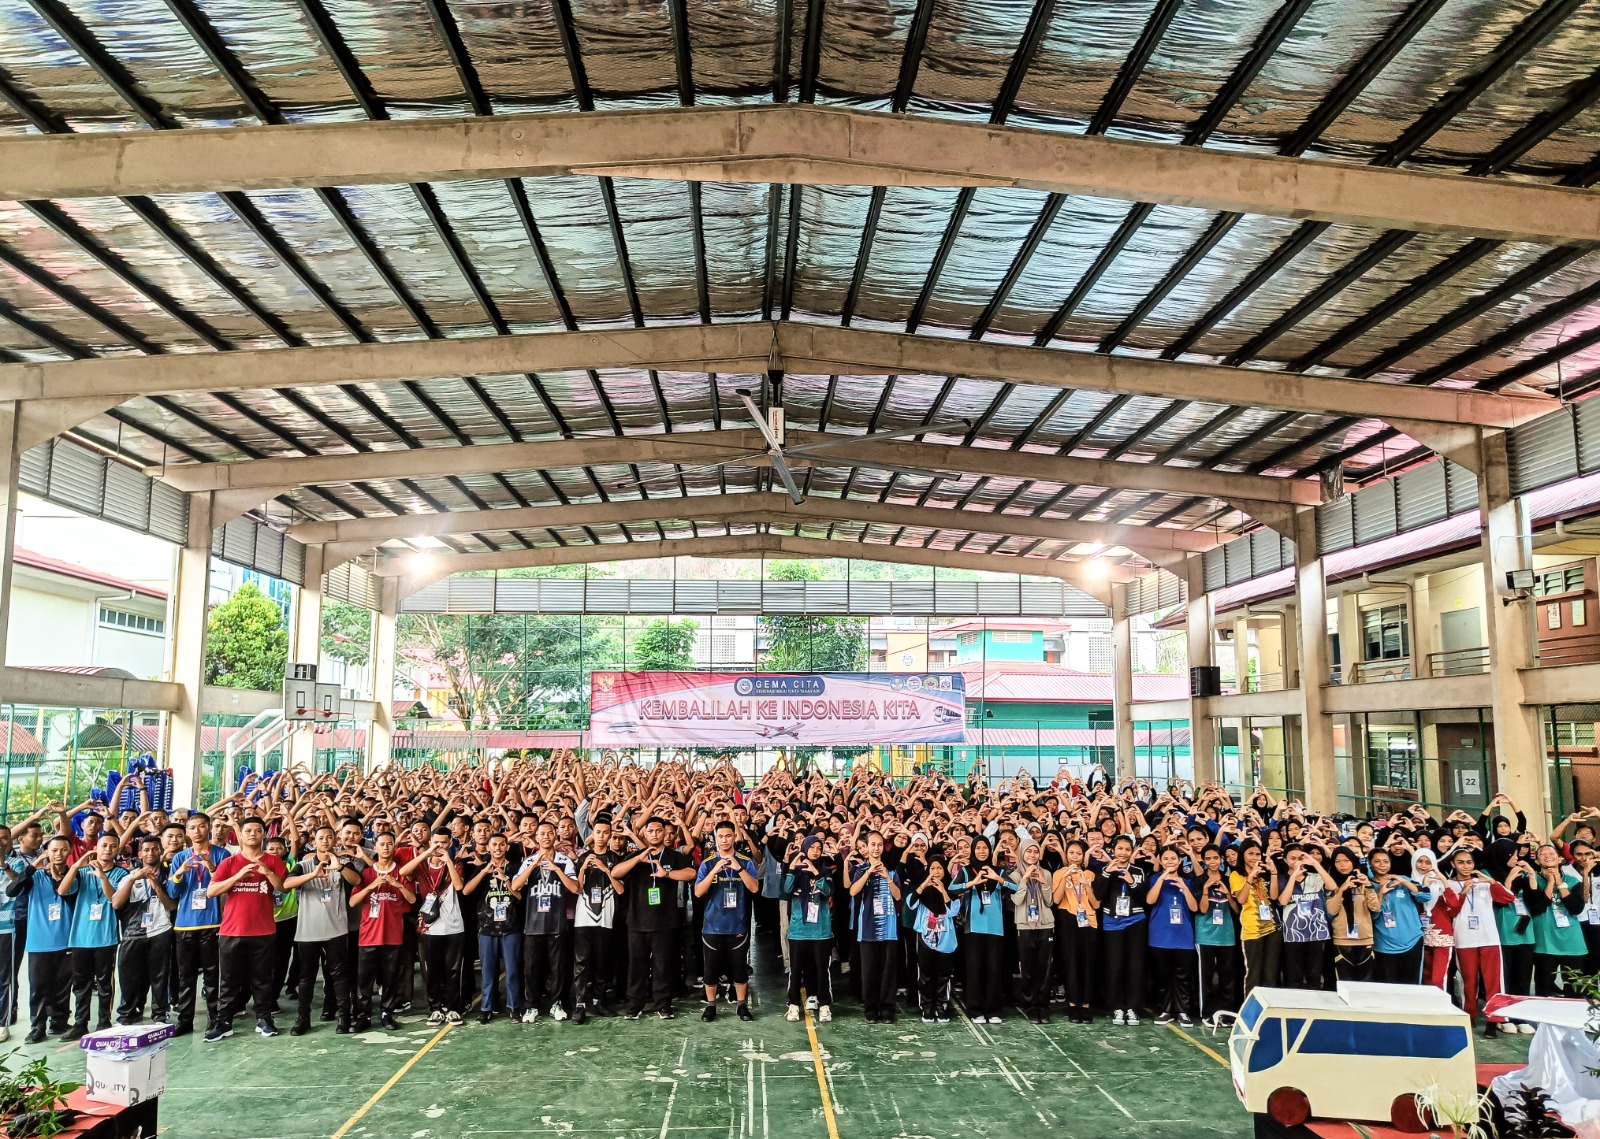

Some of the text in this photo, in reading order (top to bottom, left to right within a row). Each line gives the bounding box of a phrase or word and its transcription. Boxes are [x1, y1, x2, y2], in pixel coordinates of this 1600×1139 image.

[755, 680, 820, 688] GEMA CITA
[639, 700, 921, 720] KEMBALILAH KE INDONESIA KITA
[148, 1029, 167, 1040] QUALITY
